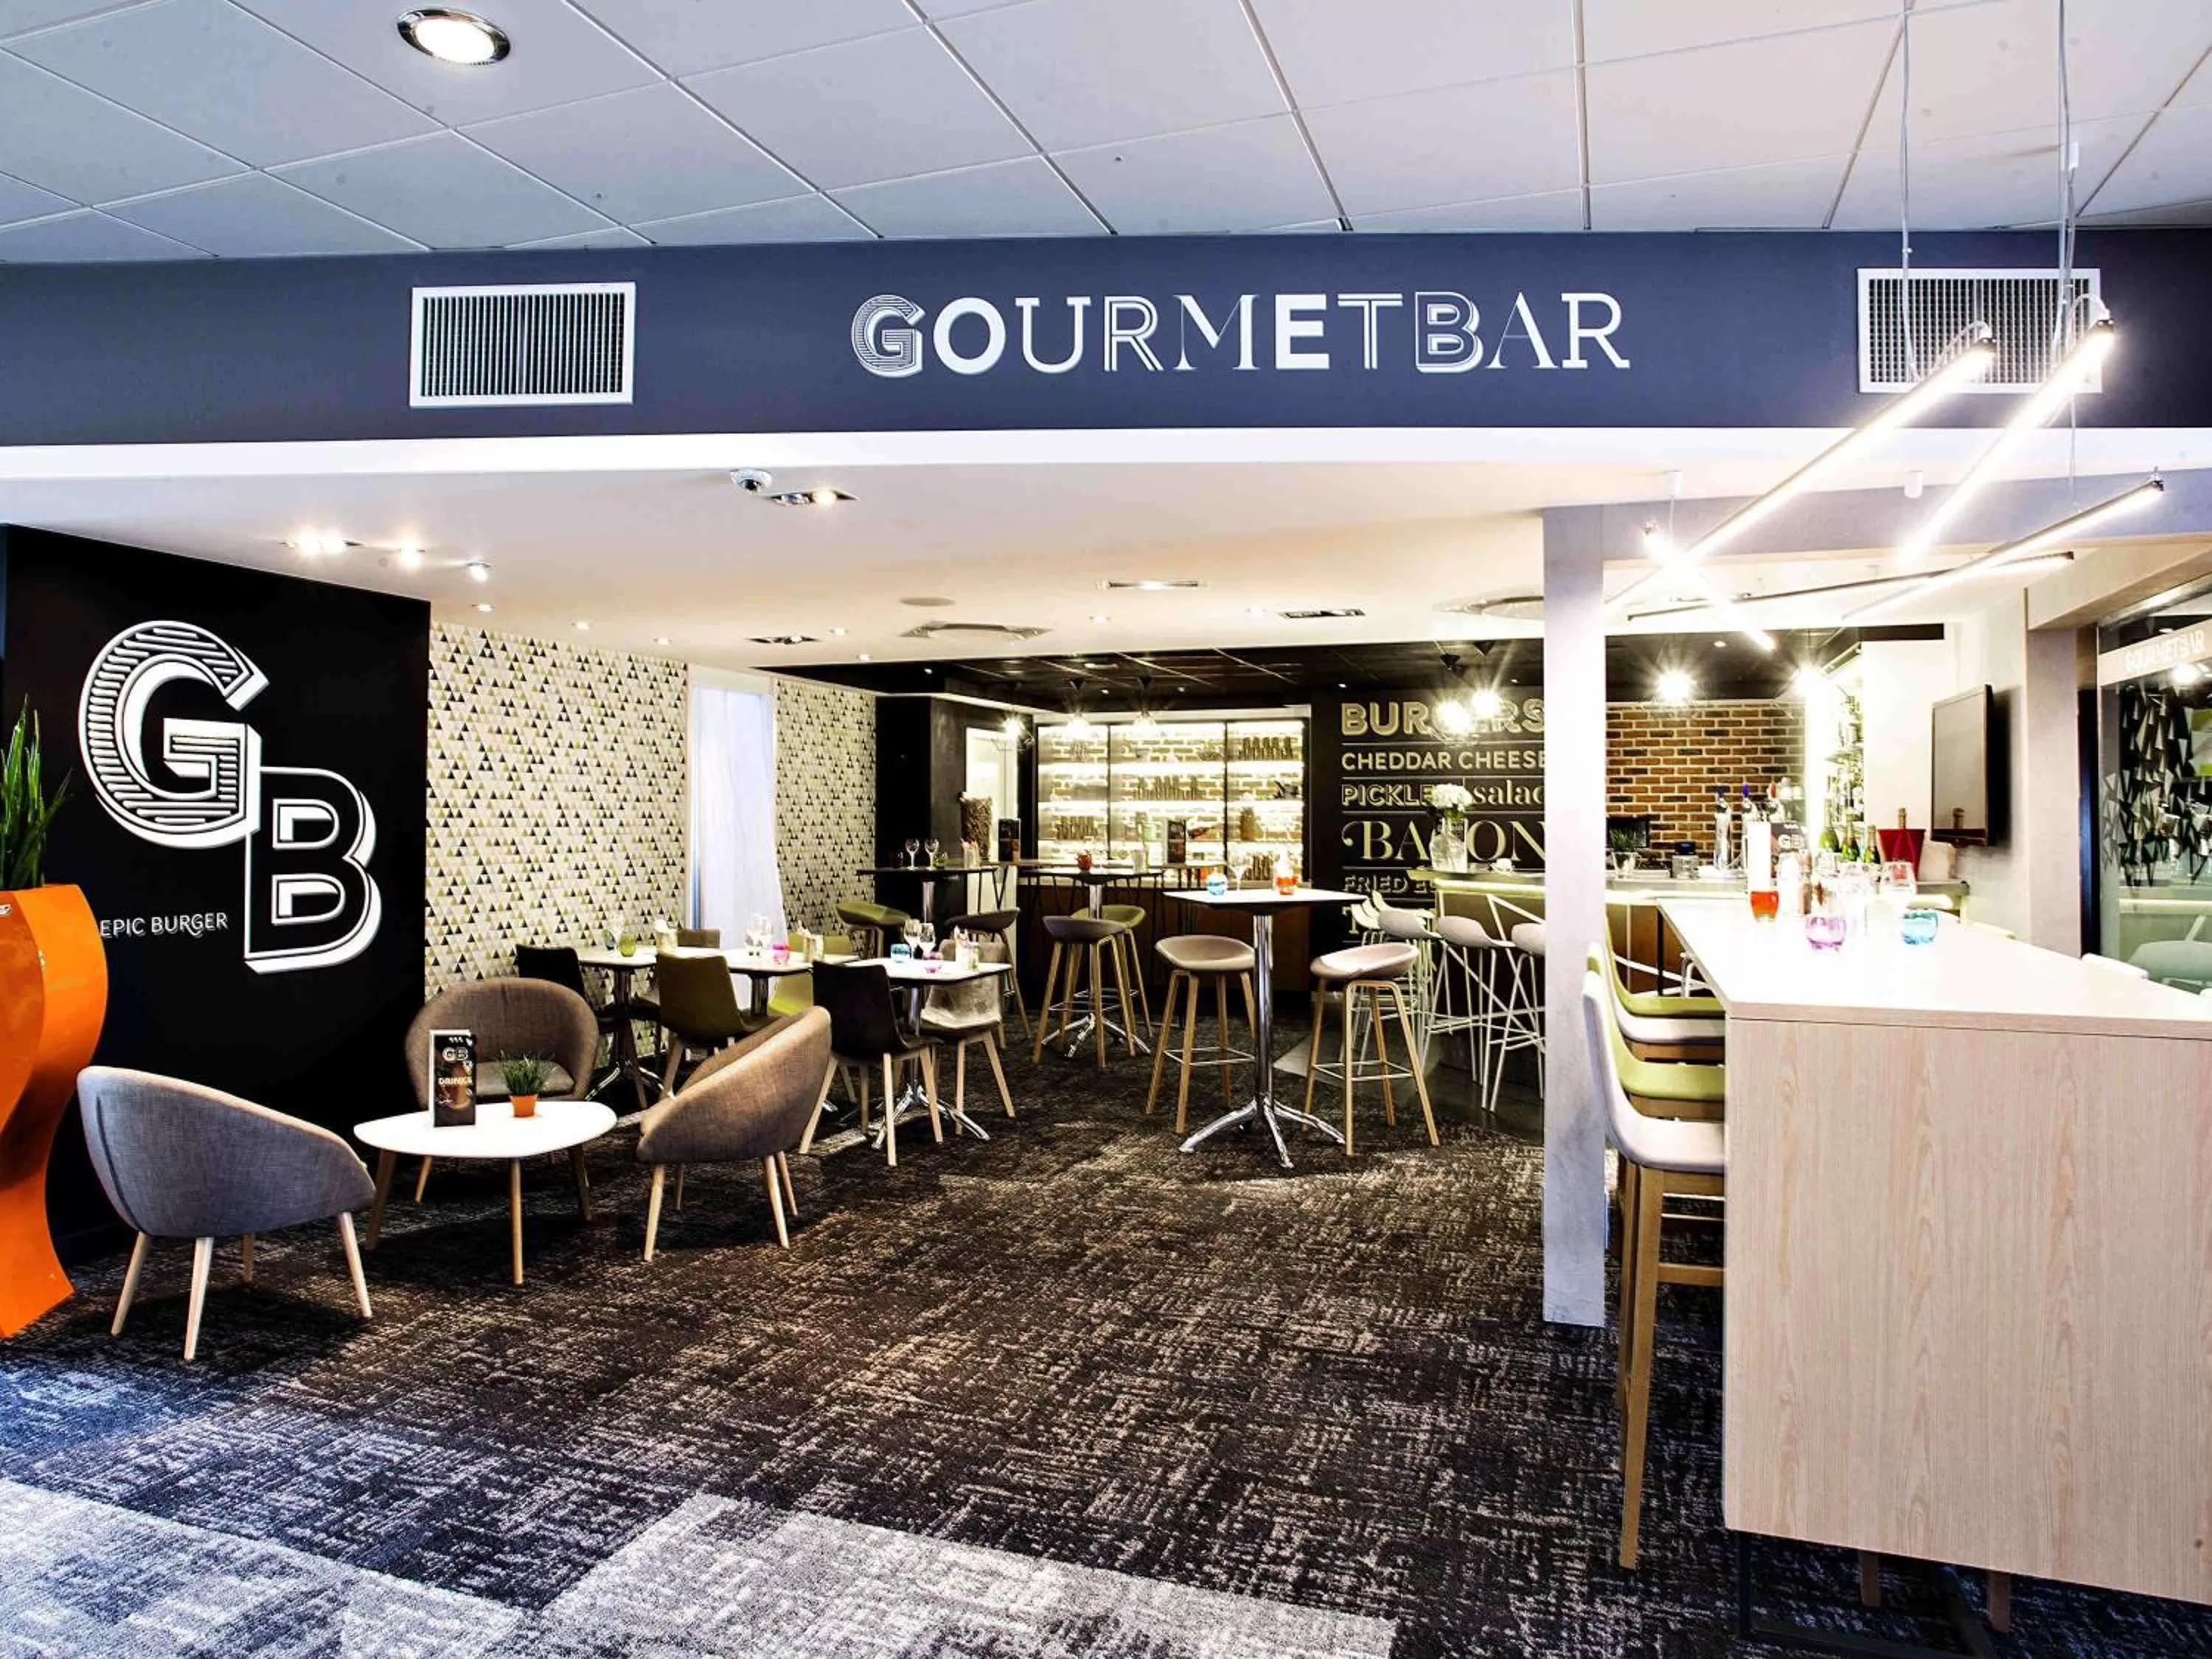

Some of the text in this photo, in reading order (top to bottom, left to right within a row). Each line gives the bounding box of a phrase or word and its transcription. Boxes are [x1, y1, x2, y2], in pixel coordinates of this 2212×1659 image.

[1341, 698, 1545, 736] BURRS
[1341, 752, 1452, 771] CHEDDAR
[78, 619, 382, 974] GB
[1342, 784, 1438, 806] PICKLE
[1341, 819, 1545, 862] BAON
[100, 912, 229, 939] EPIC BURGER
